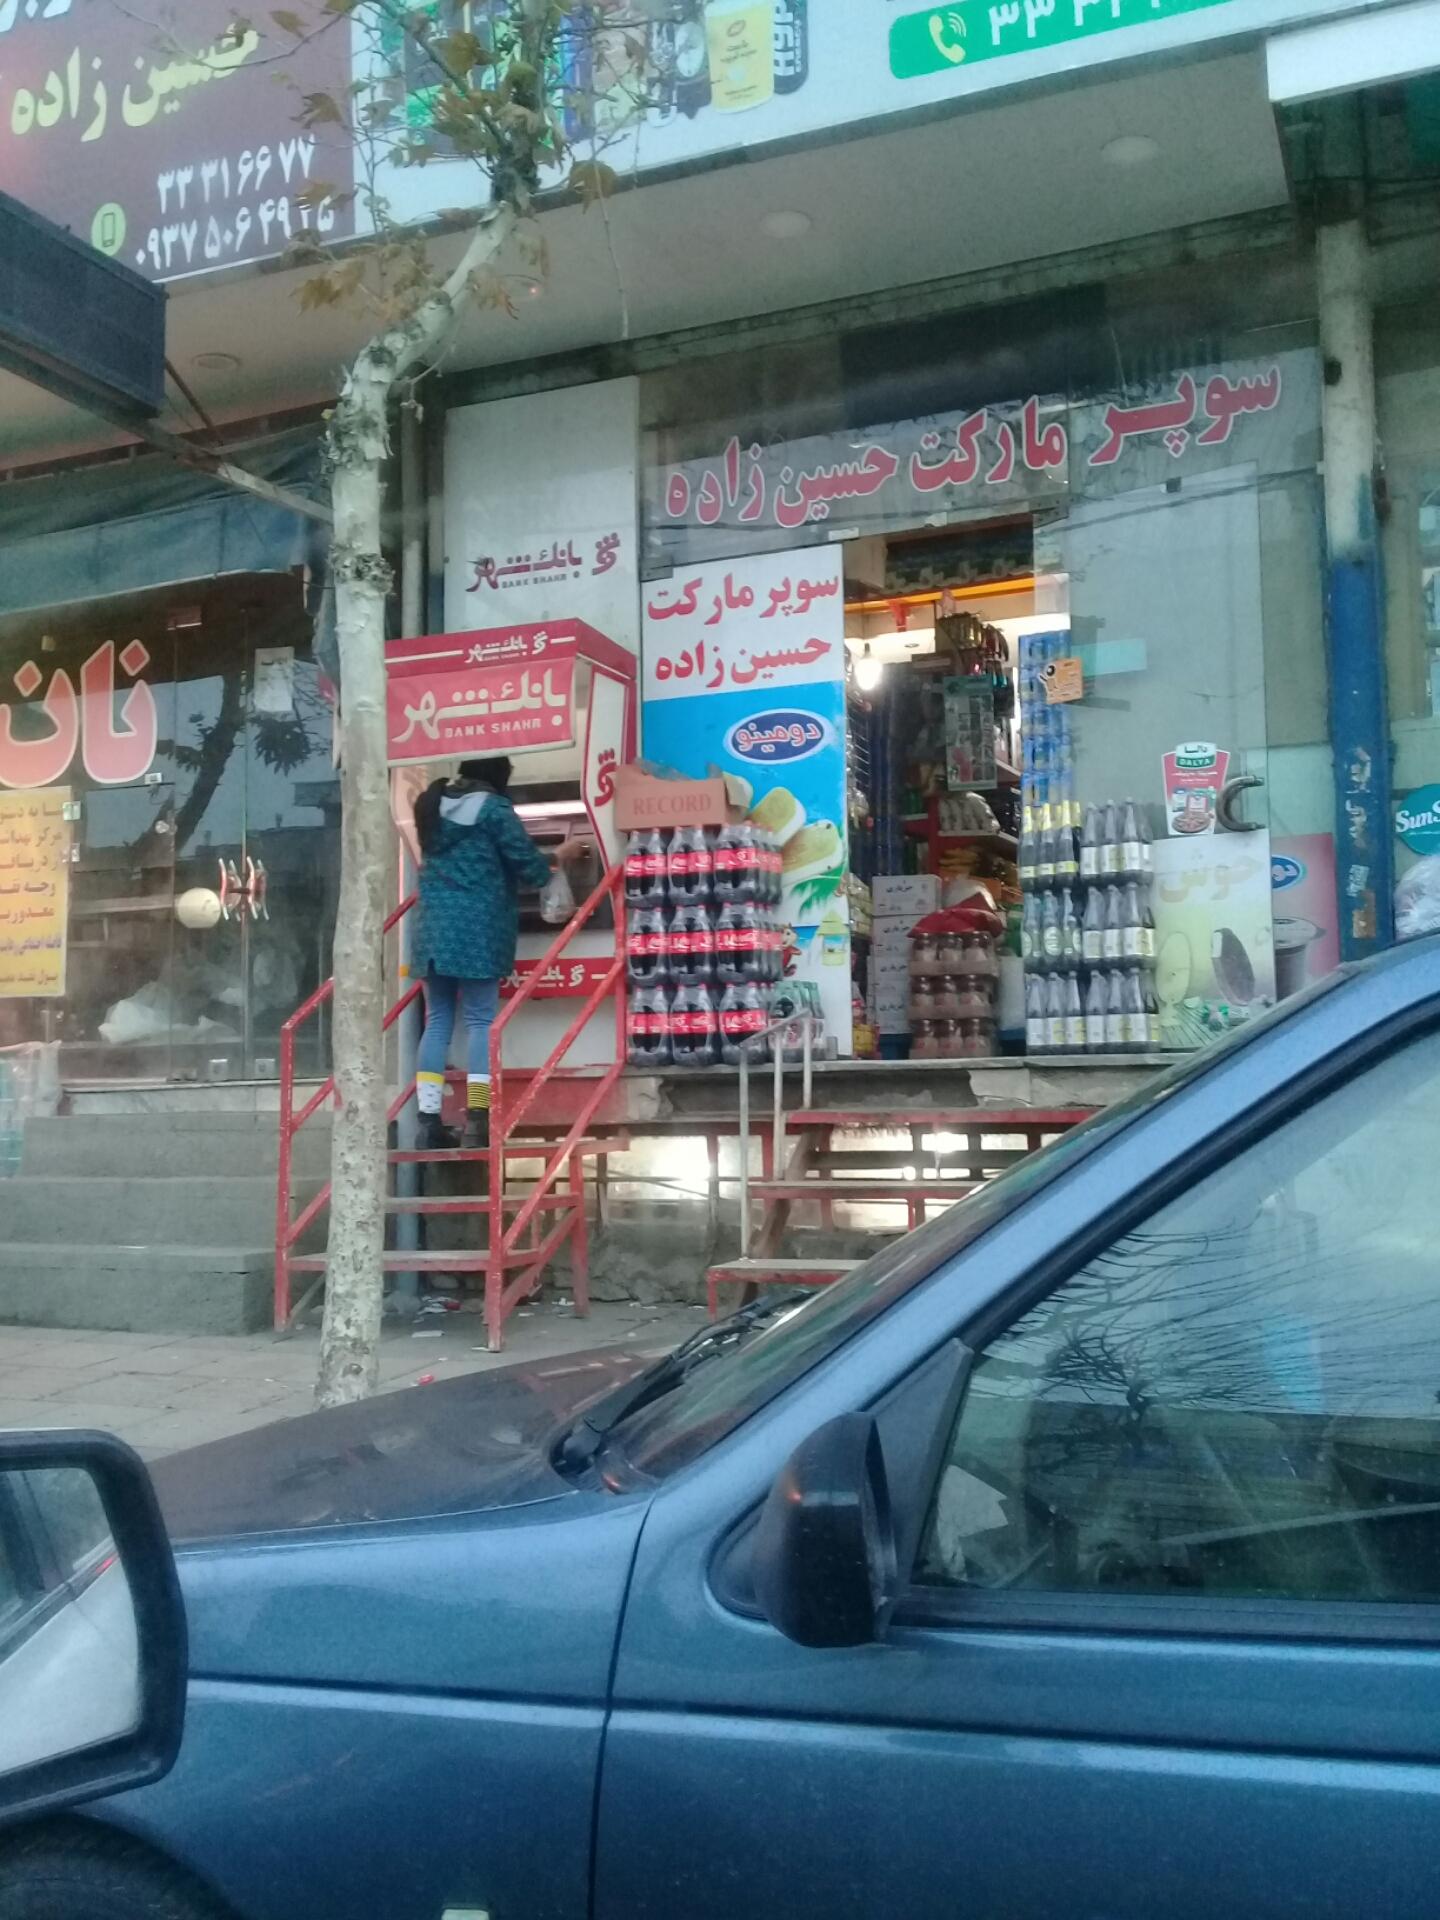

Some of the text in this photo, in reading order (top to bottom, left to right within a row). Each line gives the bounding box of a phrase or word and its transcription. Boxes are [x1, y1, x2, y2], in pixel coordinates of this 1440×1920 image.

[10, 23, 260, 143] حسین زاده
[665, 364, 1283, 528] سوپر مارکت حسین زاده
[647, 572, 840, 626] سوپر مارکت
[655, 637, 833, 689] حسین زاده
[0, 638, 158, 789] نان
[445, 717, 542, 739] BANK SHAHR
[735, 721, 823, 753] دومینو
[632, 793, 713, 815] RECORD
